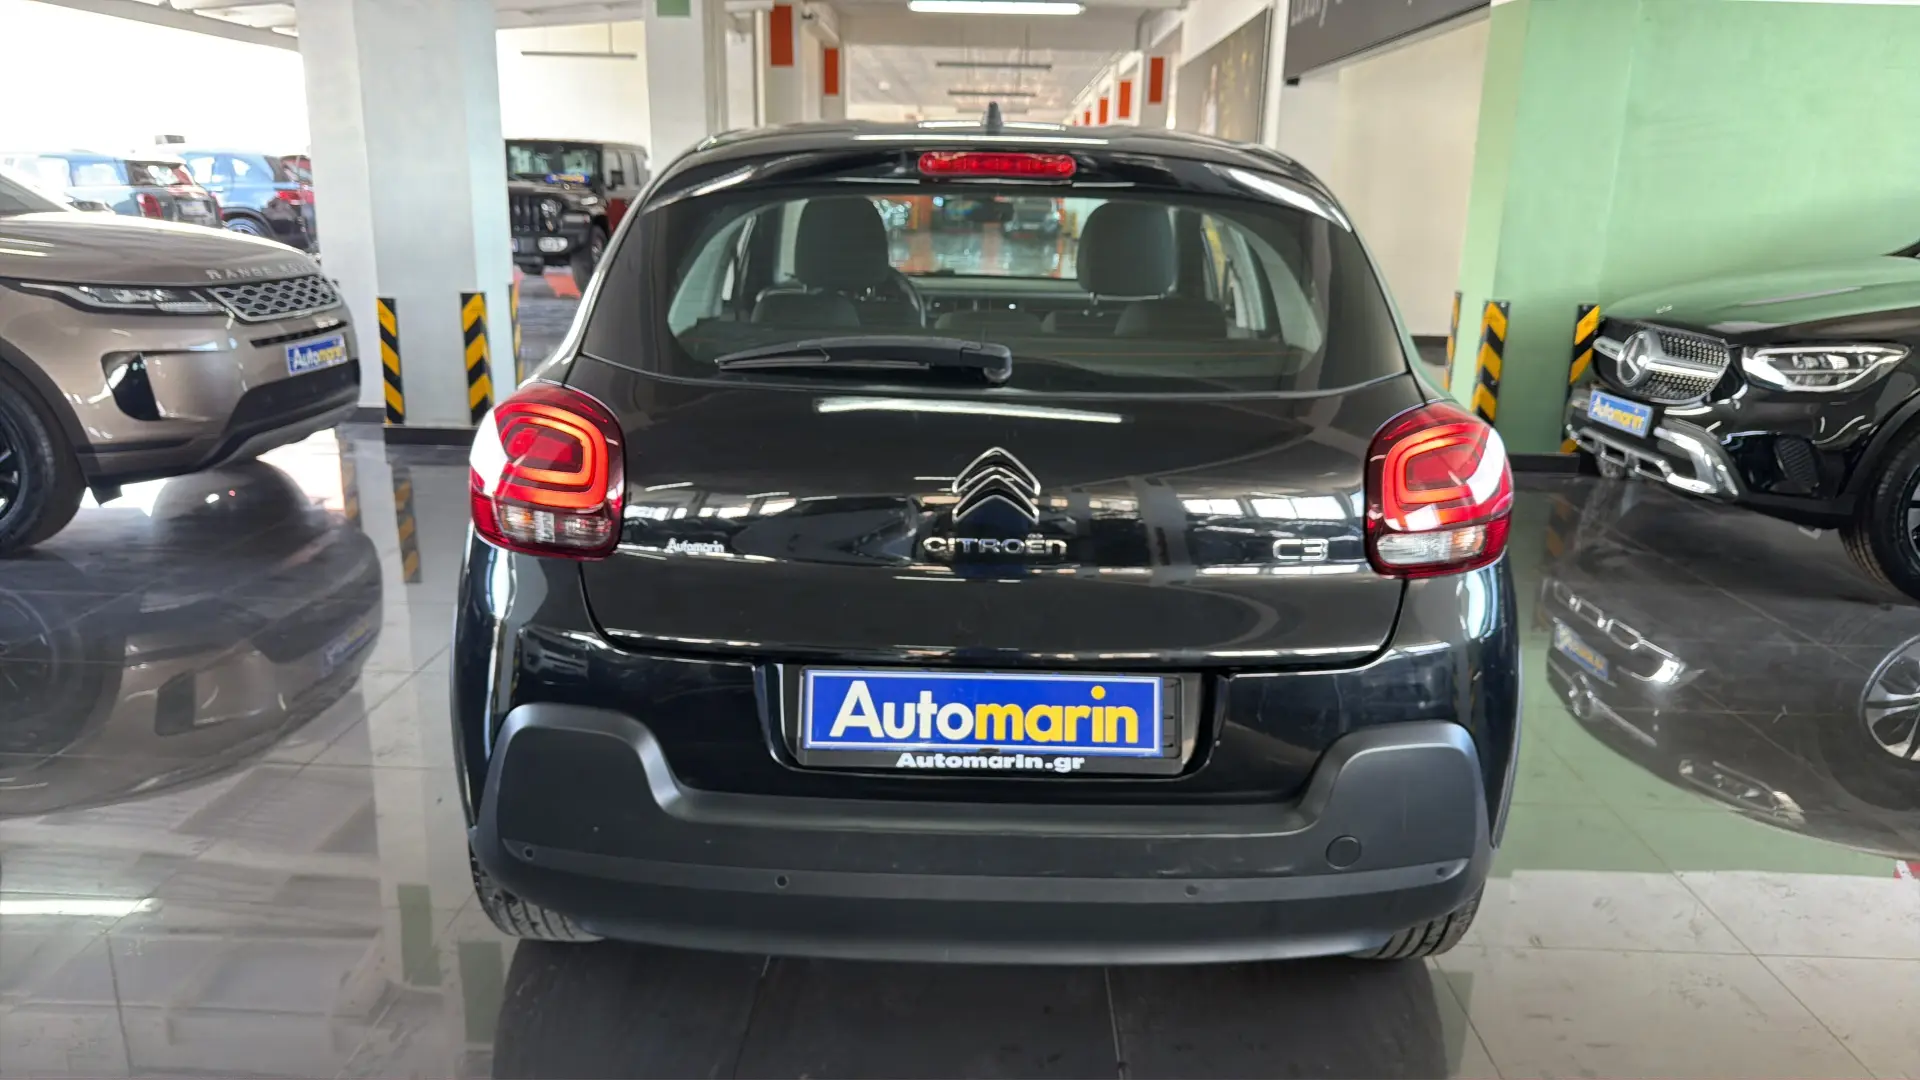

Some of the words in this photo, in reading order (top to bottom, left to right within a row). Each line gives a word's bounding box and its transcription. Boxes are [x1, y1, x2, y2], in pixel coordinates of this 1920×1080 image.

[205, 265, 273, 281] RANGE
[663, 537, 724, 554] Automarin
[1272, 538, 1329, 561] C3
[829, 680, 1139, 744] Automarin
[895, 752, 1086, 773] Automarin.gr
